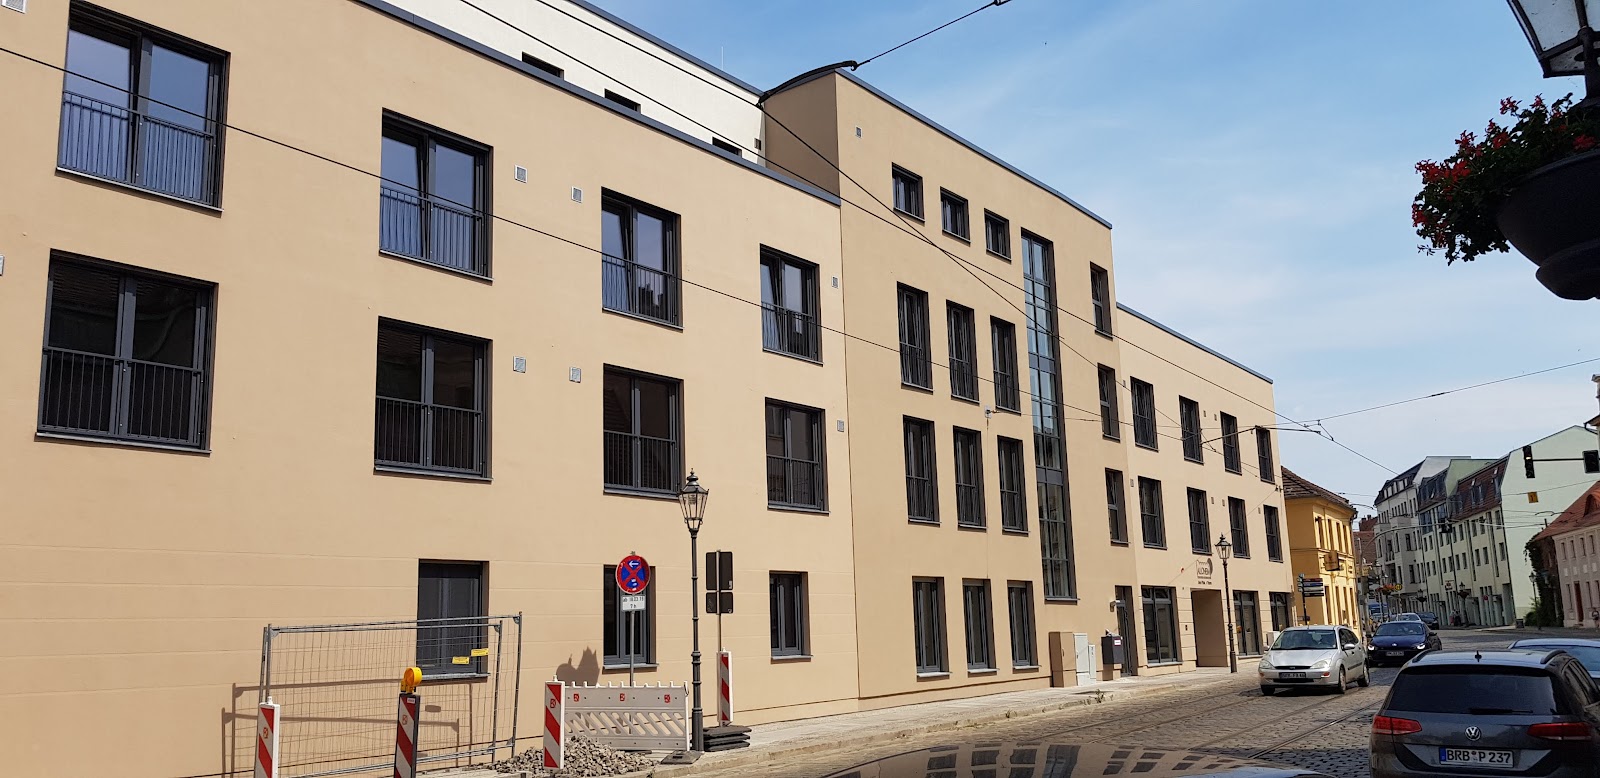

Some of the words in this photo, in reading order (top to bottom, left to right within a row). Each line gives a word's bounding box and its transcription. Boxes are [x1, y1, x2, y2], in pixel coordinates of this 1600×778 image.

[1464, 725, 1481, 741] VW
[1446, 749, 1470, 761] BRB
[1478, 751, 1486, 762] P
[1488, 752, 1511, 764] 237
